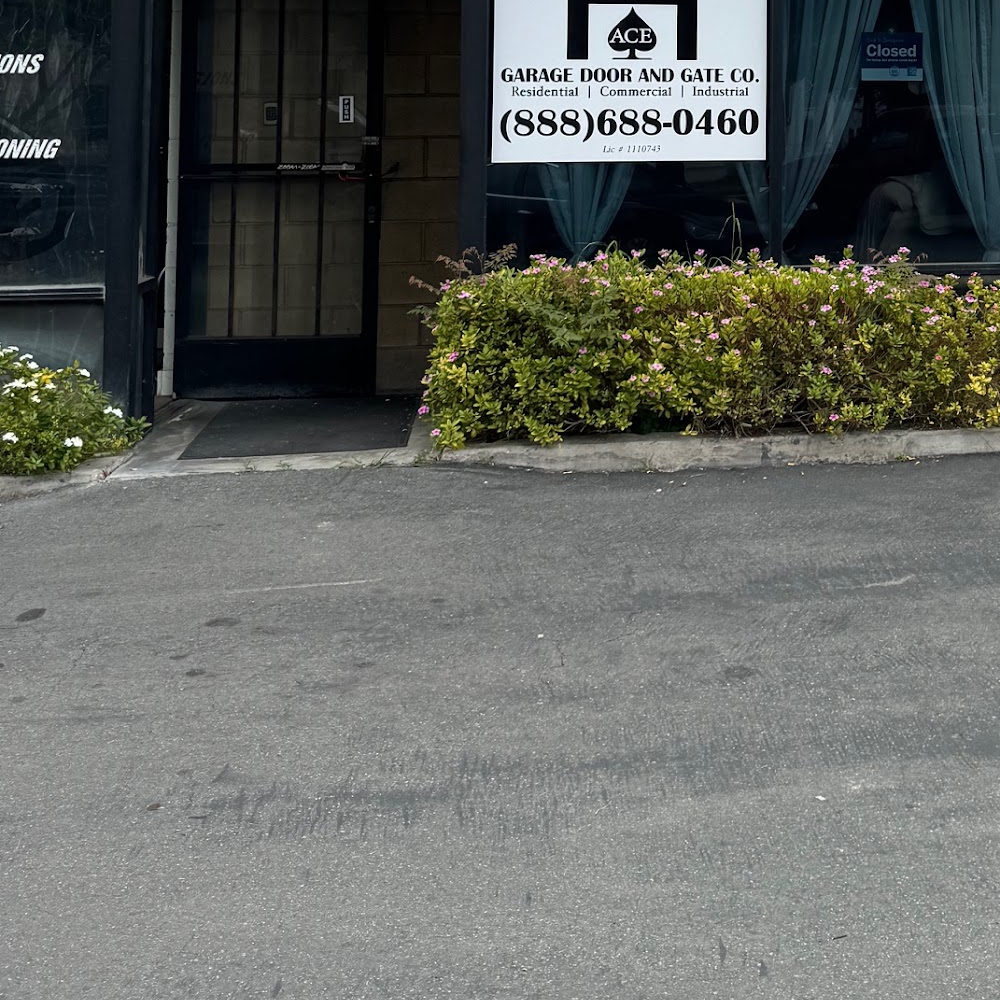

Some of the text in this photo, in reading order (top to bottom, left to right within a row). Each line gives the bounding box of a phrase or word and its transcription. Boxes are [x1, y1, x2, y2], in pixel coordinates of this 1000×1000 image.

[609, 28, 653, 44] ACE
[866, 44, 917, 57] Closed
[0, 53, 45, 75] ONS
[500, 67, 760, 83] GARAGE DOOR AND GATE CO.
[511, 85, 749, 97] Residential Commercial Industrial
[499, 108, 760, 144] (888)688-0460
